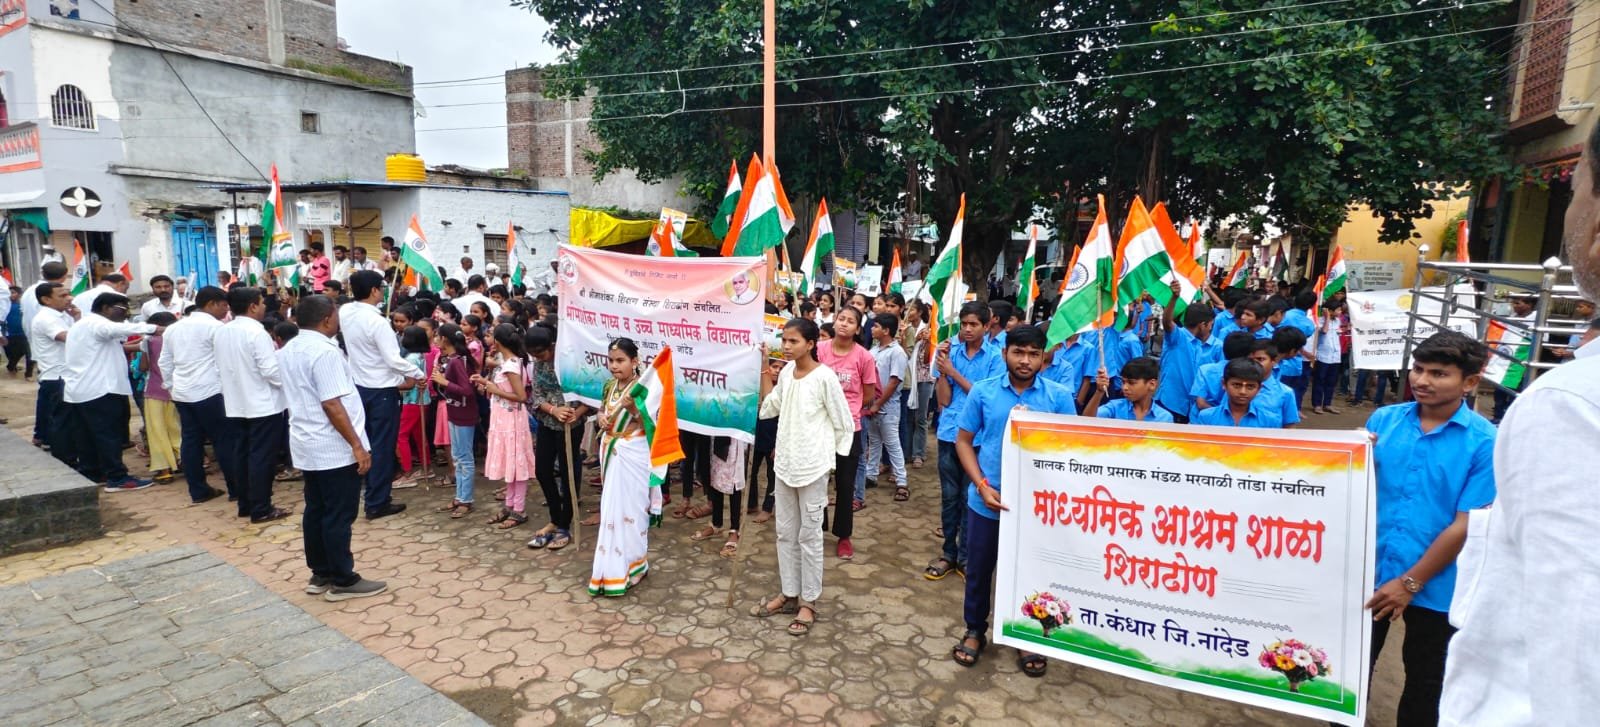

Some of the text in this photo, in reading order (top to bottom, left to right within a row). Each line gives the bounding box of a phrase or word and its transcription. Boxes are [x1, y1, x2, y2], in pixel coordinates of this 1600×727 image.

[618, 292, 639, 305] शिक्षण
[623, 317, 631, 333] व
[633, 318, 654, 336] उच्च
[657, 318, 702, 341] माध्यमिक
[679, 366, 728, 390] स्वागत
[1033, 458, 1325, 497] बालक शिक्षण प्रसारक मंडळ मरवाळी तांडा संचलित
[1033, 484, 1326, 563] माध्यमिक आश्रम शाळा
[1103, 542, 1218, 597] शिराढोण
